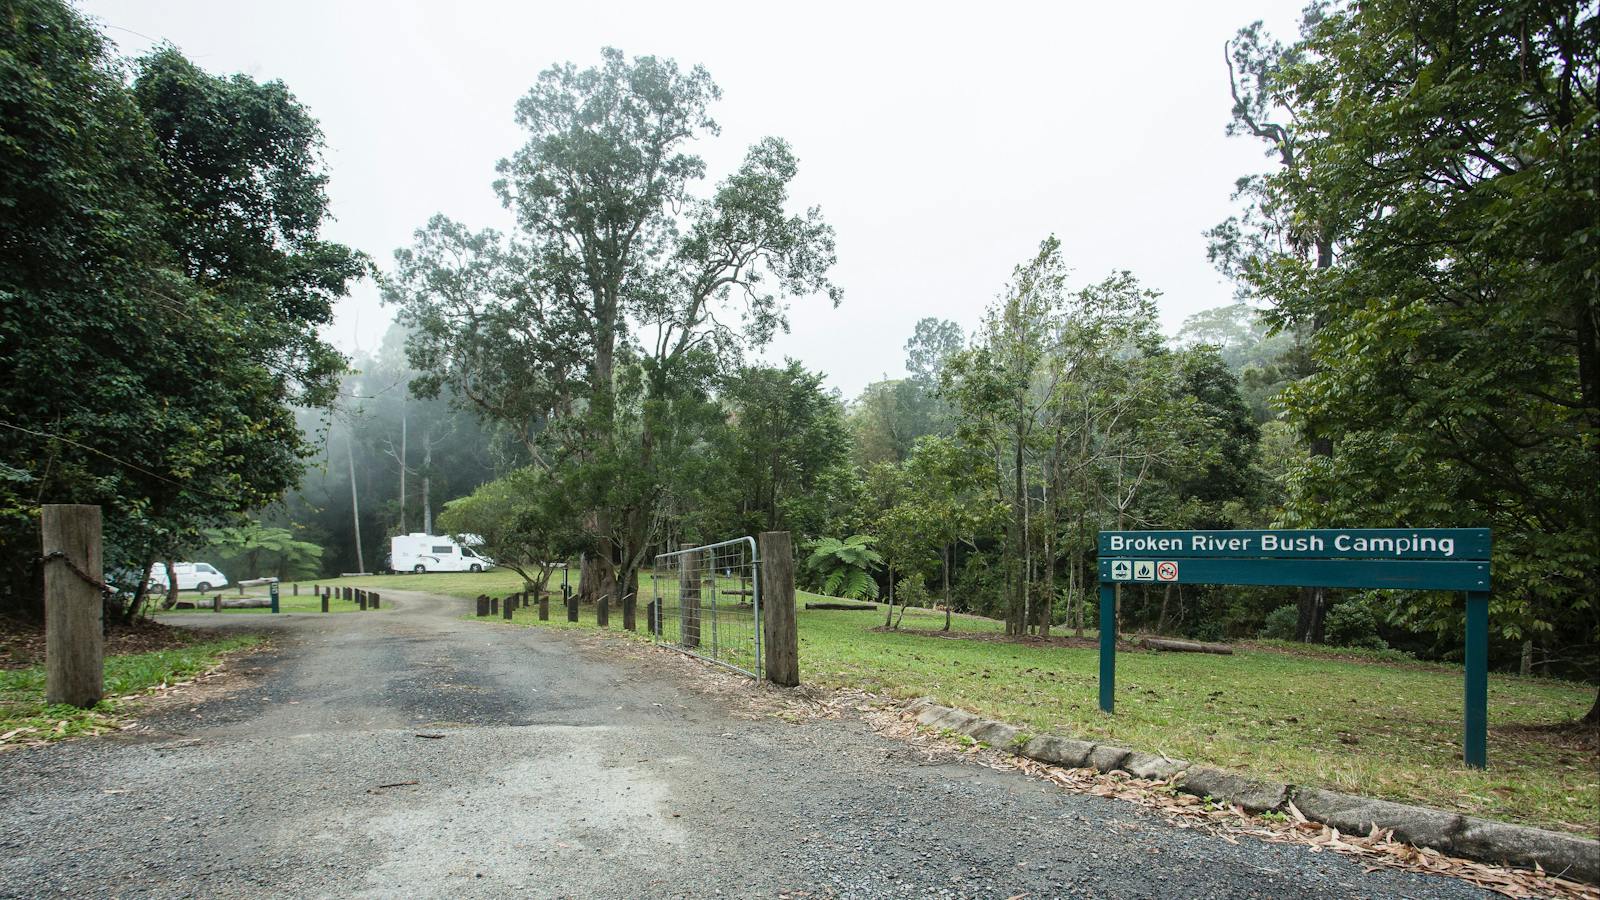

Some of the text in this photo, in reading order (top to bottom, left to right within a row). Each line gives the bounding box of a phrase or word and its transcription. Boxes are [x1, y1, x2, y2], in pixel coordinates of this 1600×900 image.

[1110, 534, 1455, 556] Broken River Bush Camping
